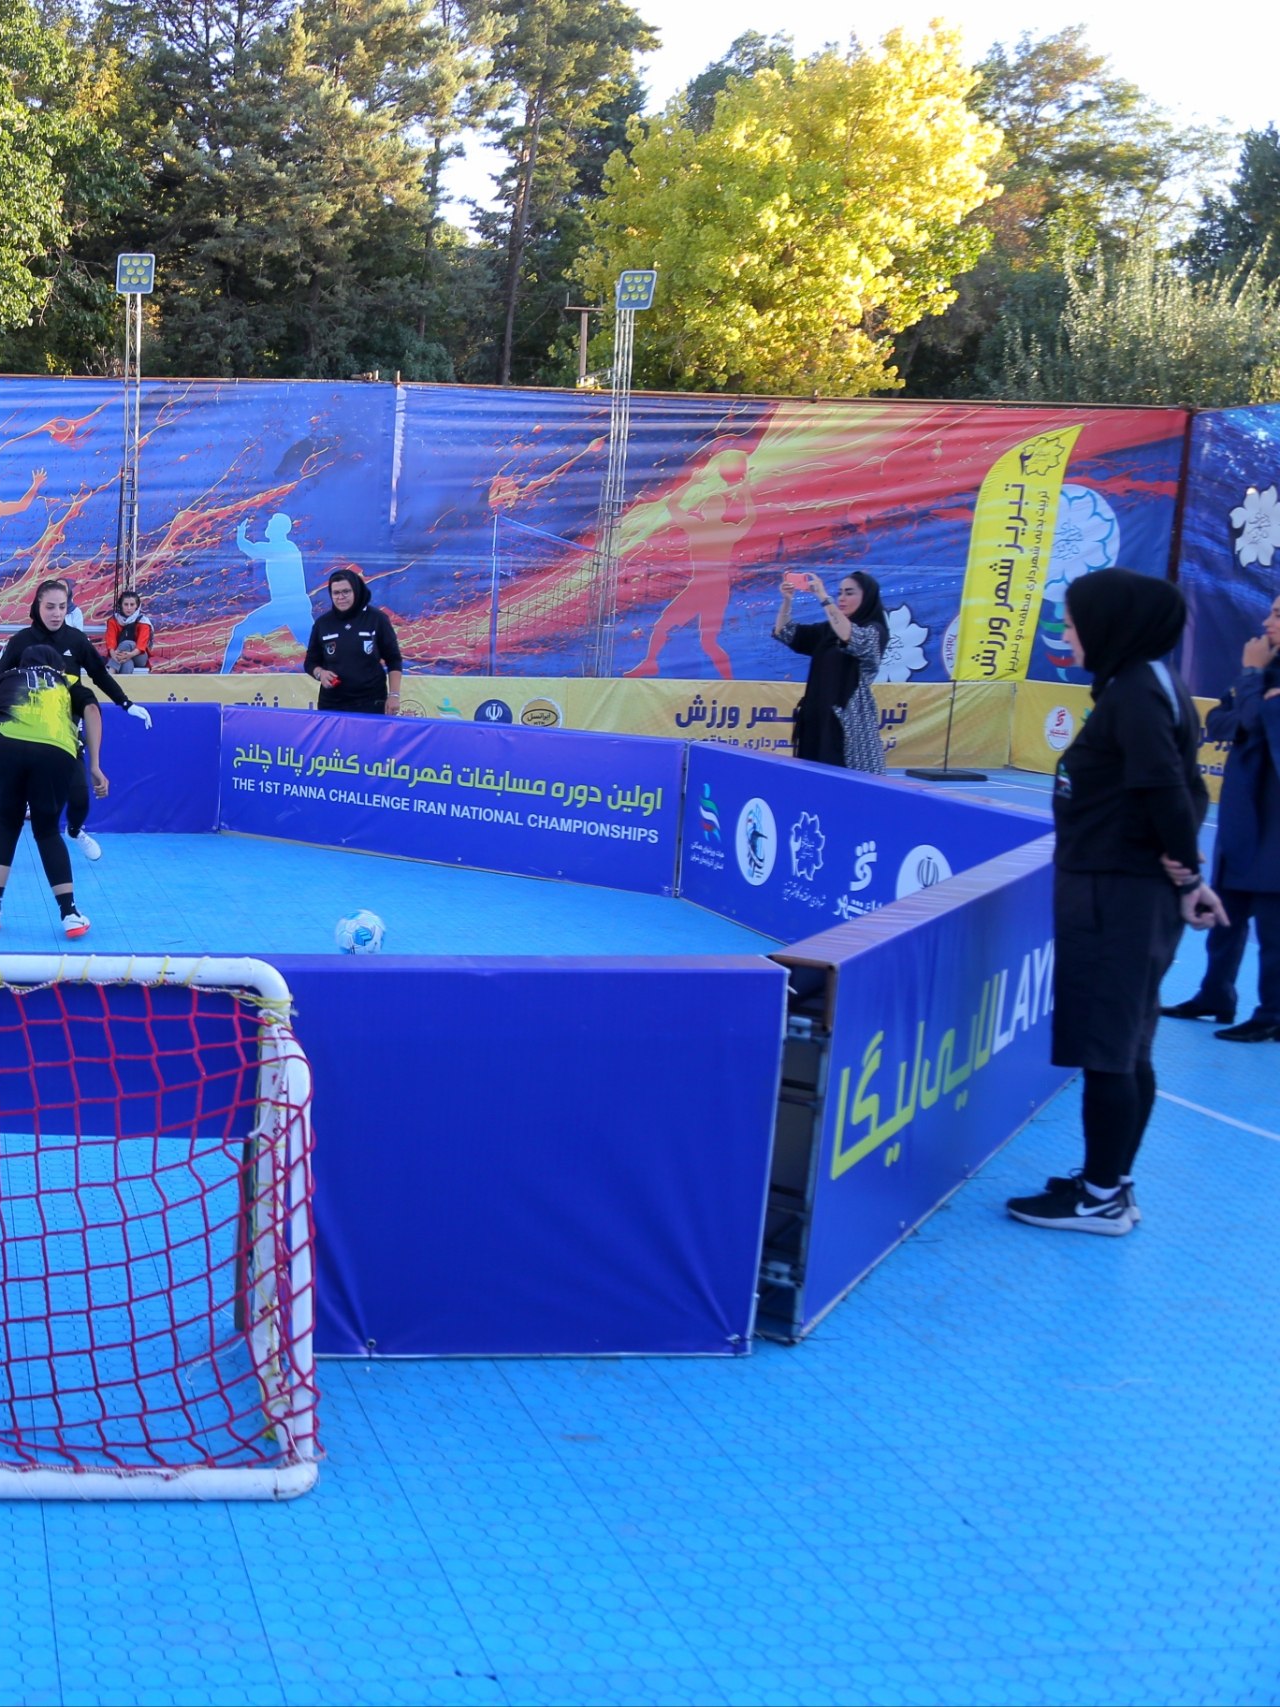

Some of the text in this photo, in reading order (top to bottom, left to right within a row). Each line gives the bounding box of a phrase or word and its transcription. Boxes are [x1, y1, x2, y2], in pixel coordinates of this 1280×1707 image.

[971, 483, 1028, 676] تبریز شهر ورزش
[675, 694, 908, 731] تبر هر ورزش
[744, 736, 799, 751] هرداری
[232, 777, 659, 844] THE 1ST PANNA CHALLENGE IRAN NATIONAL CHAMPIONSHIPS
[233, 744, 663, 817] اولین دوره مسابقات قهرمانی کشور پانا چلنج
[993, 938, 1054, 1055] LAYI
